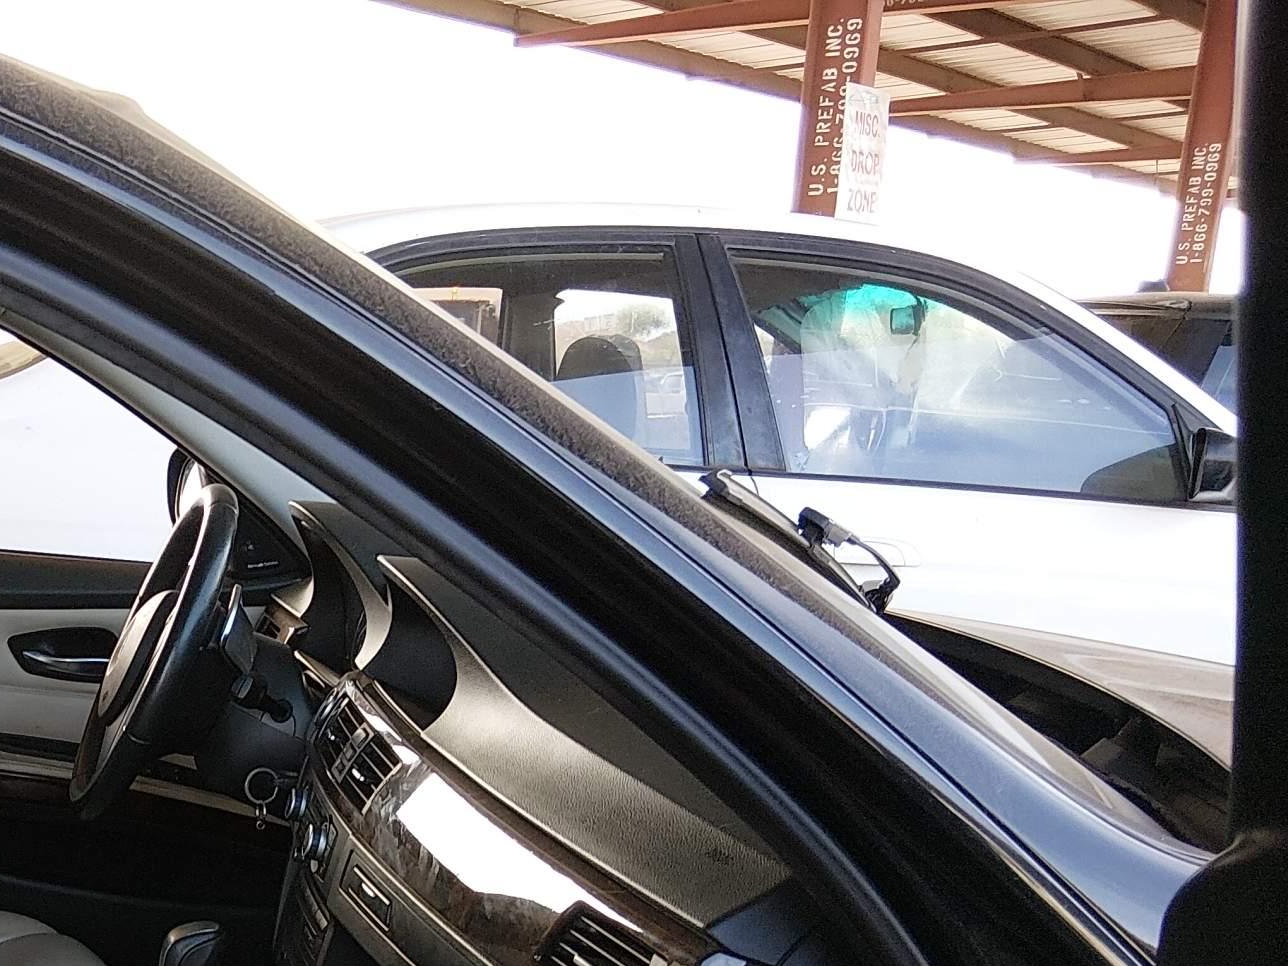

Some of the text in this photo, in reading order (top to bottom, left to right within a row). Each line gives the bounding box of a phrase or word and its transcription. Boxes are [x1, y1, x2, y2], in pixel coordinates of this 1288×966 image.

[808, 18, 844, 195] U.S. PREFAB INC.
[1176, 143, 1208, 264] U.S. PREFAB INC.
[1190, 143, 1222, 263] 1-866-799-0969
